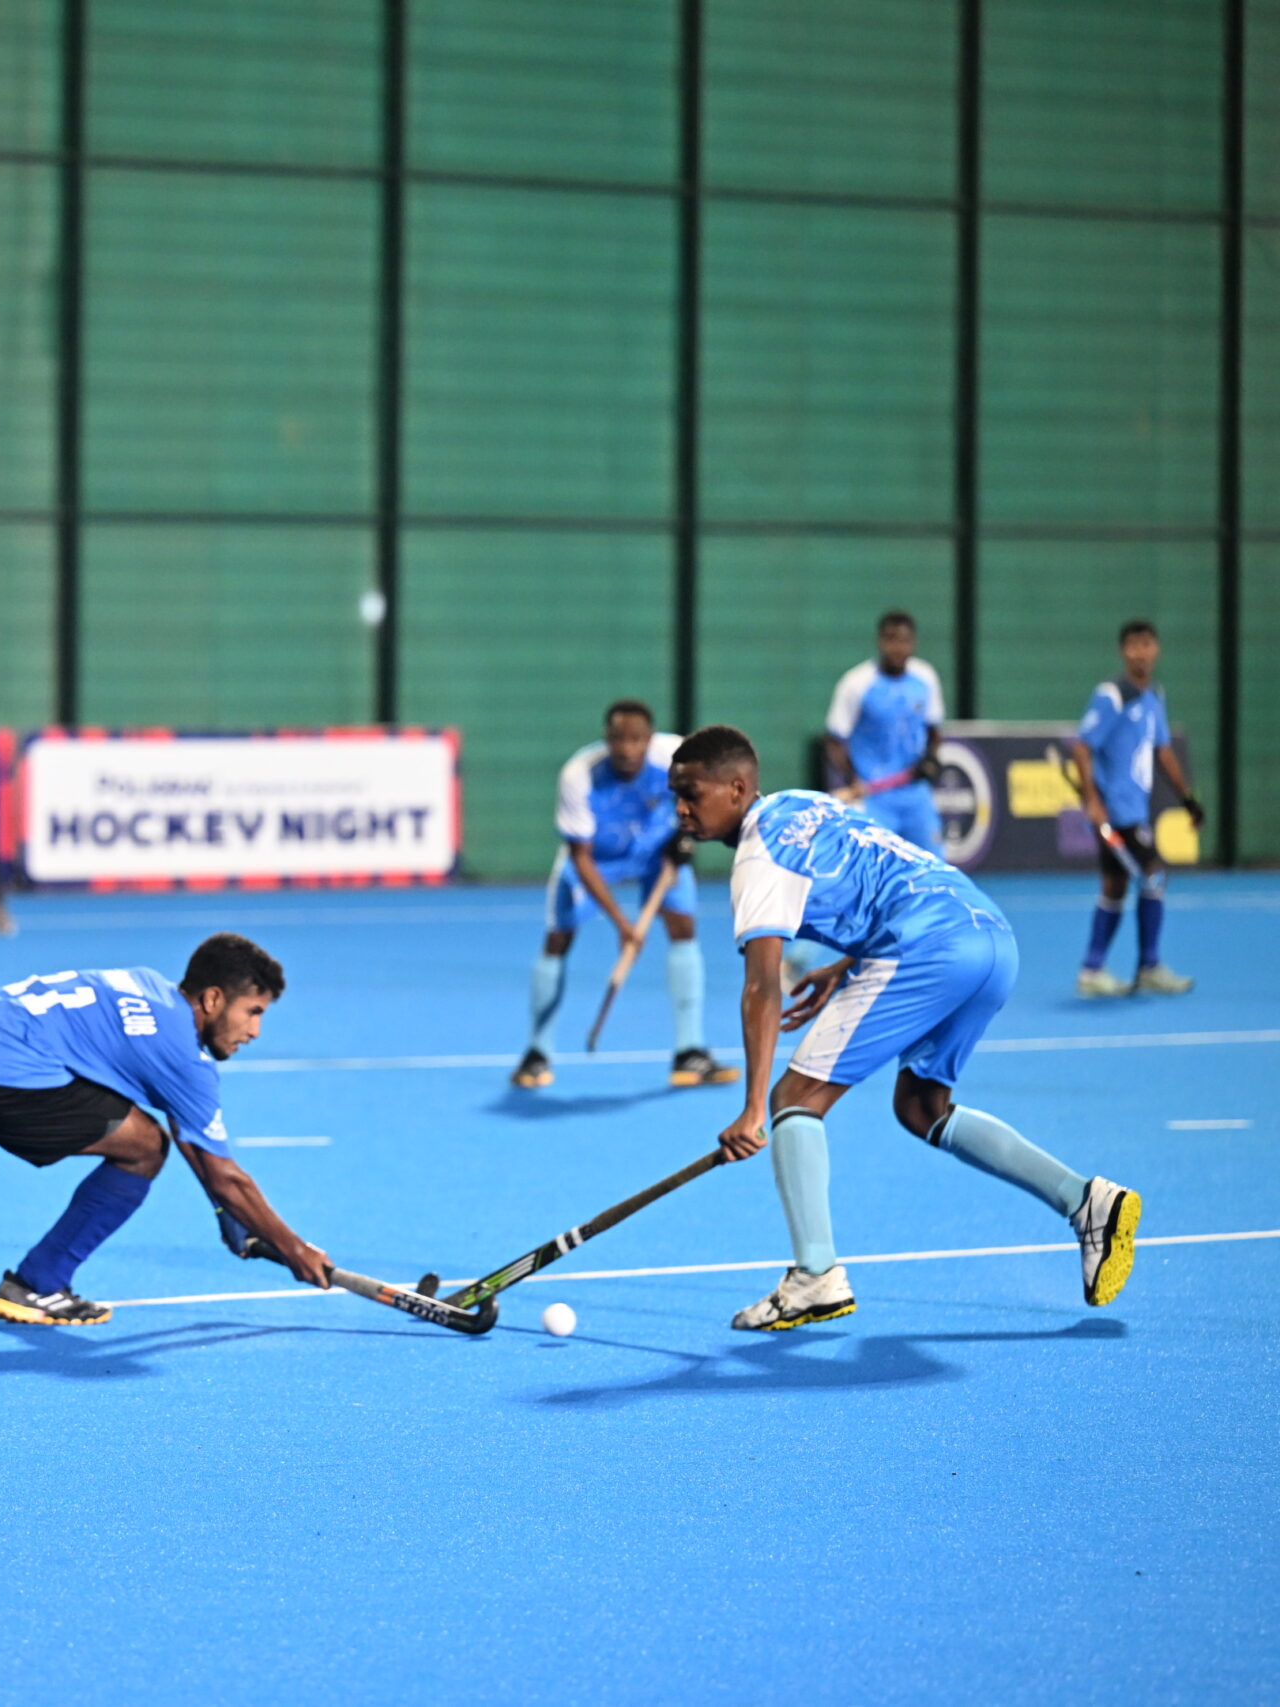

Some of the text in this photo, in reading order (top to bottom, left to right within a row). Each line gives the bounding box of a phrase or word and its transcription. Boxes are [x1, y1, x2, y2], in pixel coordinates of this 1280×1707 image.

[48, 806, 433, 845] HOCKEY NIGHT
[117, 996, 159, 1036] CLUB
